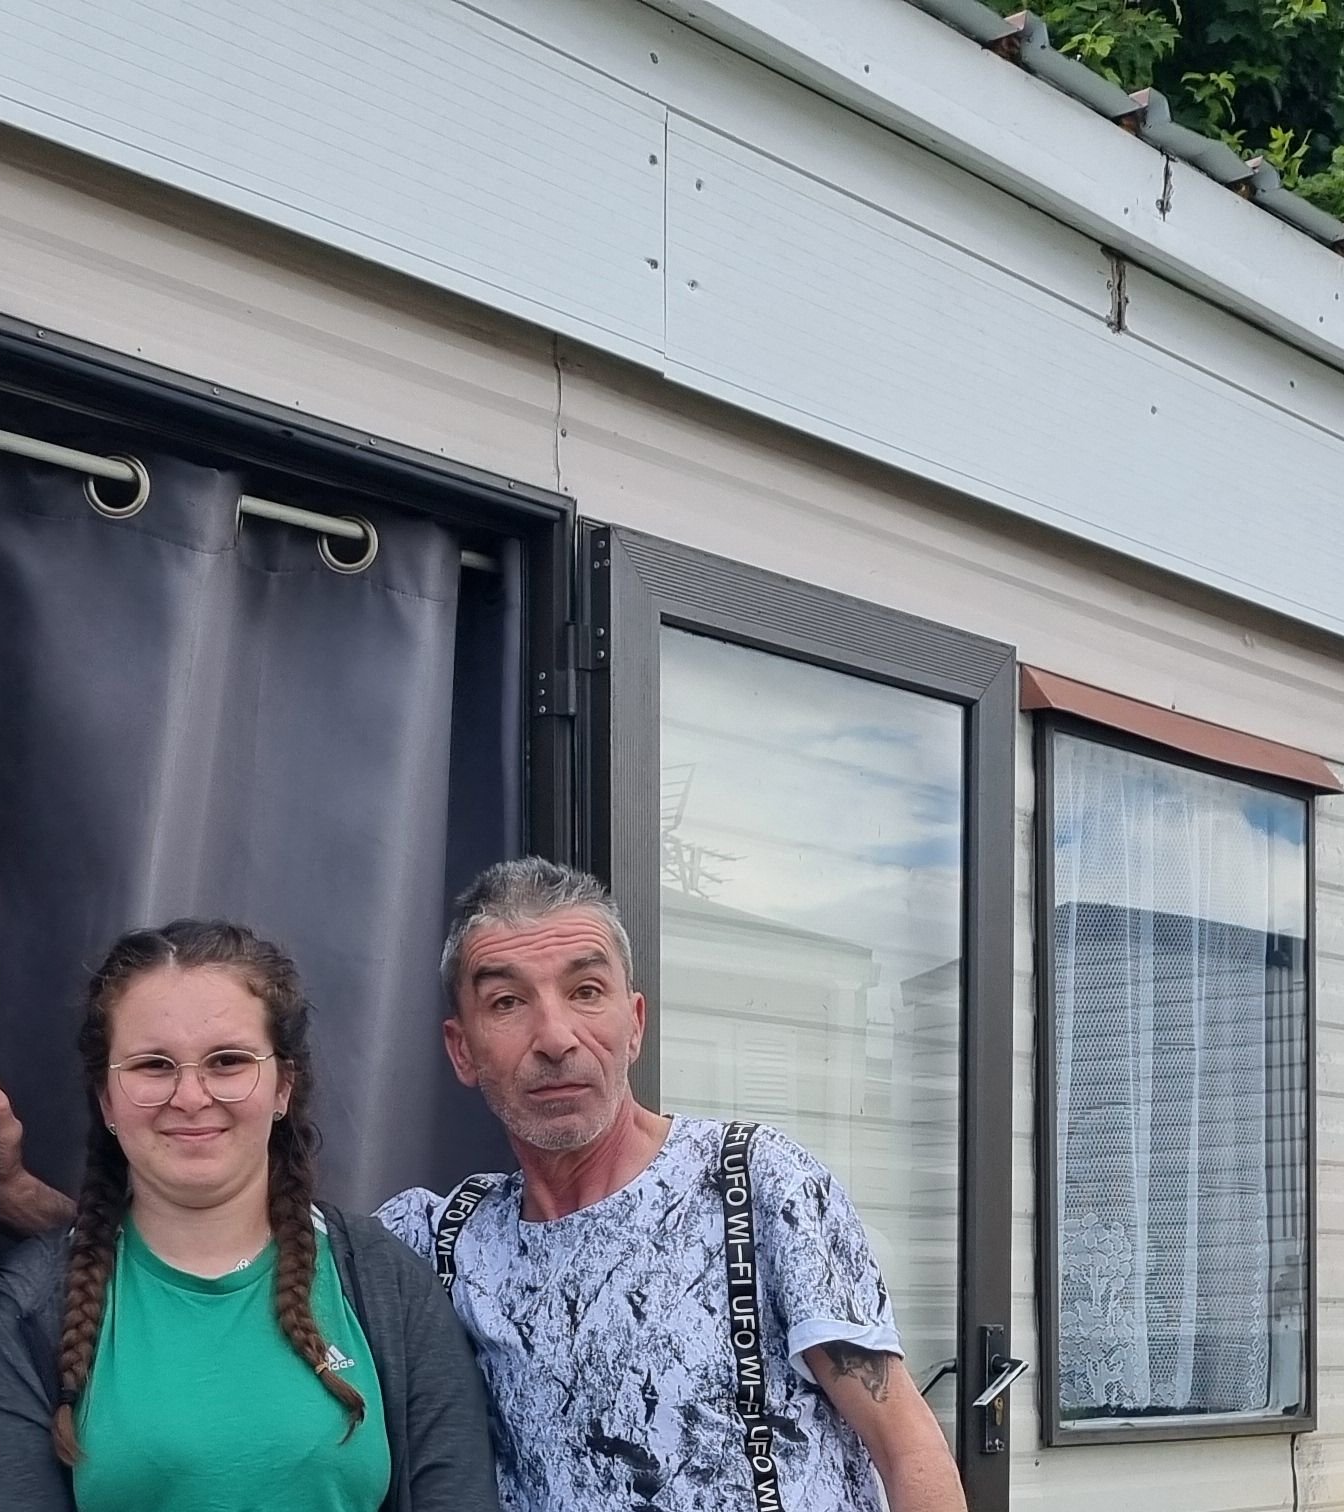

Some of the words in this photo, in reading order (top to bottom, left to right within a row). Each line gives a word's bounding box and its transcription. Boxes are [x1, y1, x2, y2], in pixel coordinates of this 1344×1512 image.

[445, 1191, 482, 1221] UFO
[723, 1153, 748, 1207] UFO
[437, 1226, 459, 1291] WI-F
[727, 1212, 753, 1285] WI-FI
[732, 1295, 756, 1349] UFO
[327, 1358, 355, 1372] idas
[739, 1355, 761, 1419] WI-FI
[747, 1425, 773, 1474] UFO
